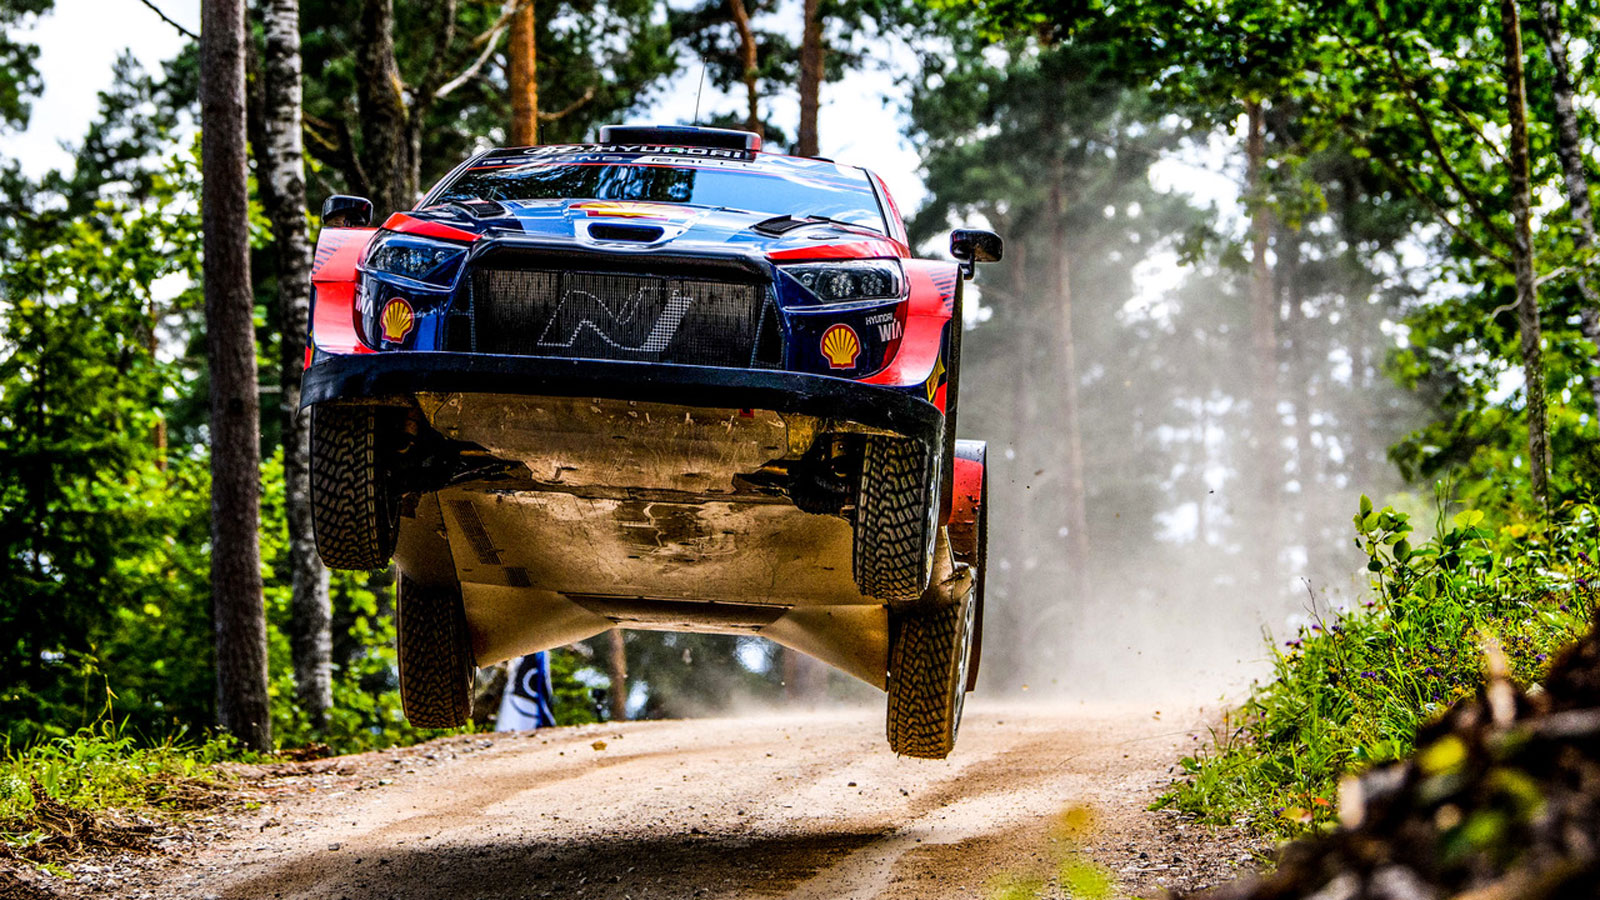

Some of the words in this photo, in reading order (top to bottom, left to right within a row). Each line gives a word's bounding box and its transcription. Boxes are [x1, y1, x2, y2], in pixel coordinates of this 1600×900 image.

[593, 145, 741, 158] HYUNDAI
[865, 312, 894, 326] HYUNDAI
[877, 318, 903, 342] WIA
